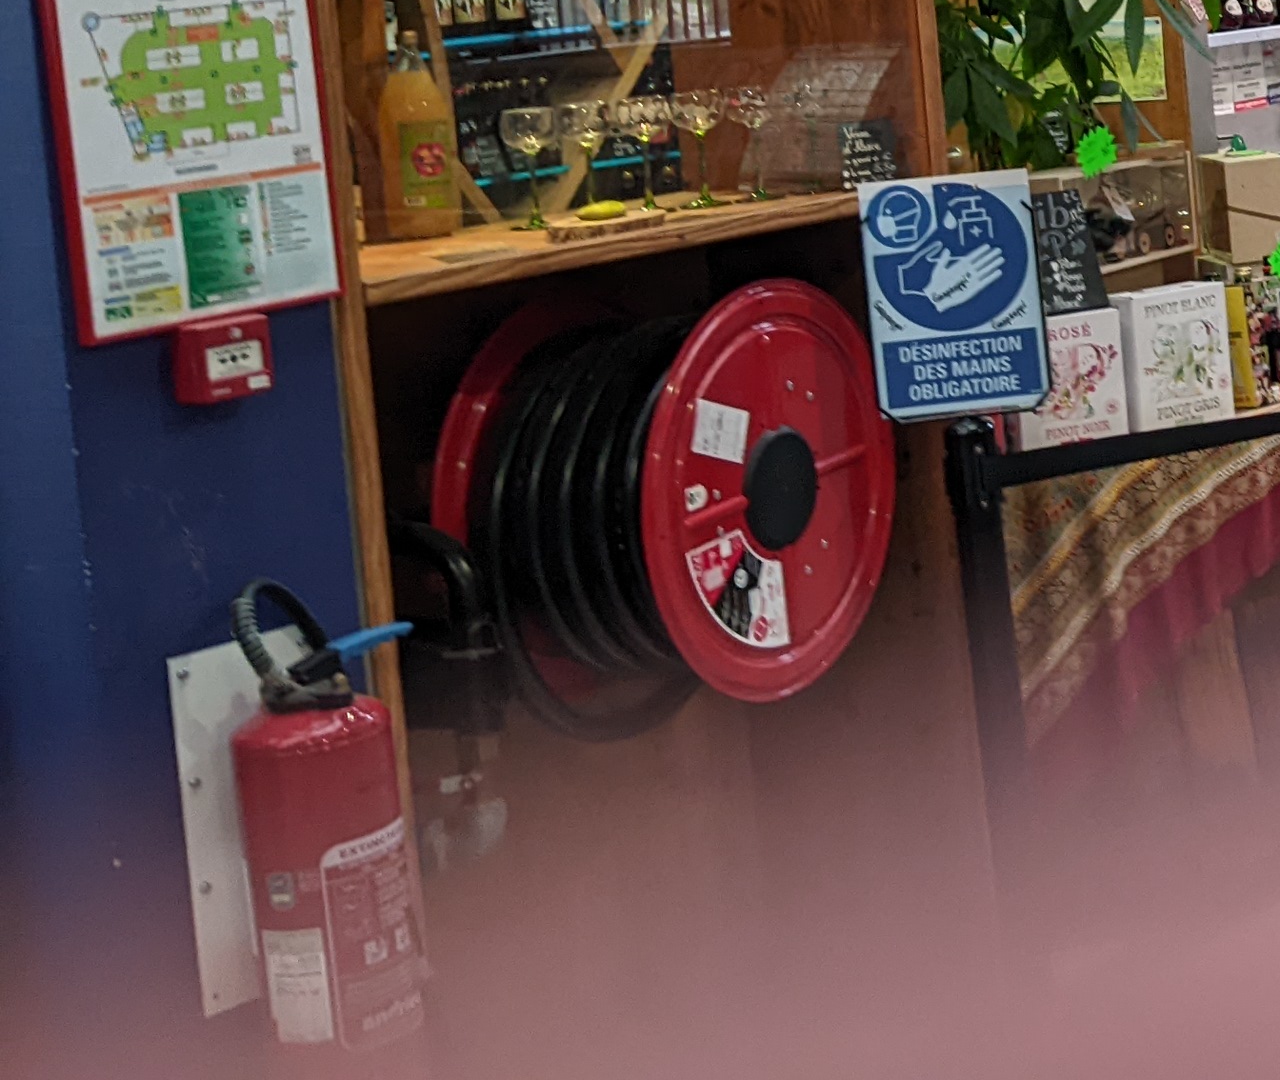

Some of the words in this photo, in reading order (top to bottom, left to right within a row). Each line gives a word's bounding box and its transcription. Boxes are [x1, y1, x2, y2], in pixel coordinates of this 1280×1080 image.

[898, 334, 1024, 364] DÉSINFECTION
[914, 362, 948, 382] DES
[951, 355, 1012, 378] MAINS
[908, 373, 1022, 402] OBLIGATOIRE
